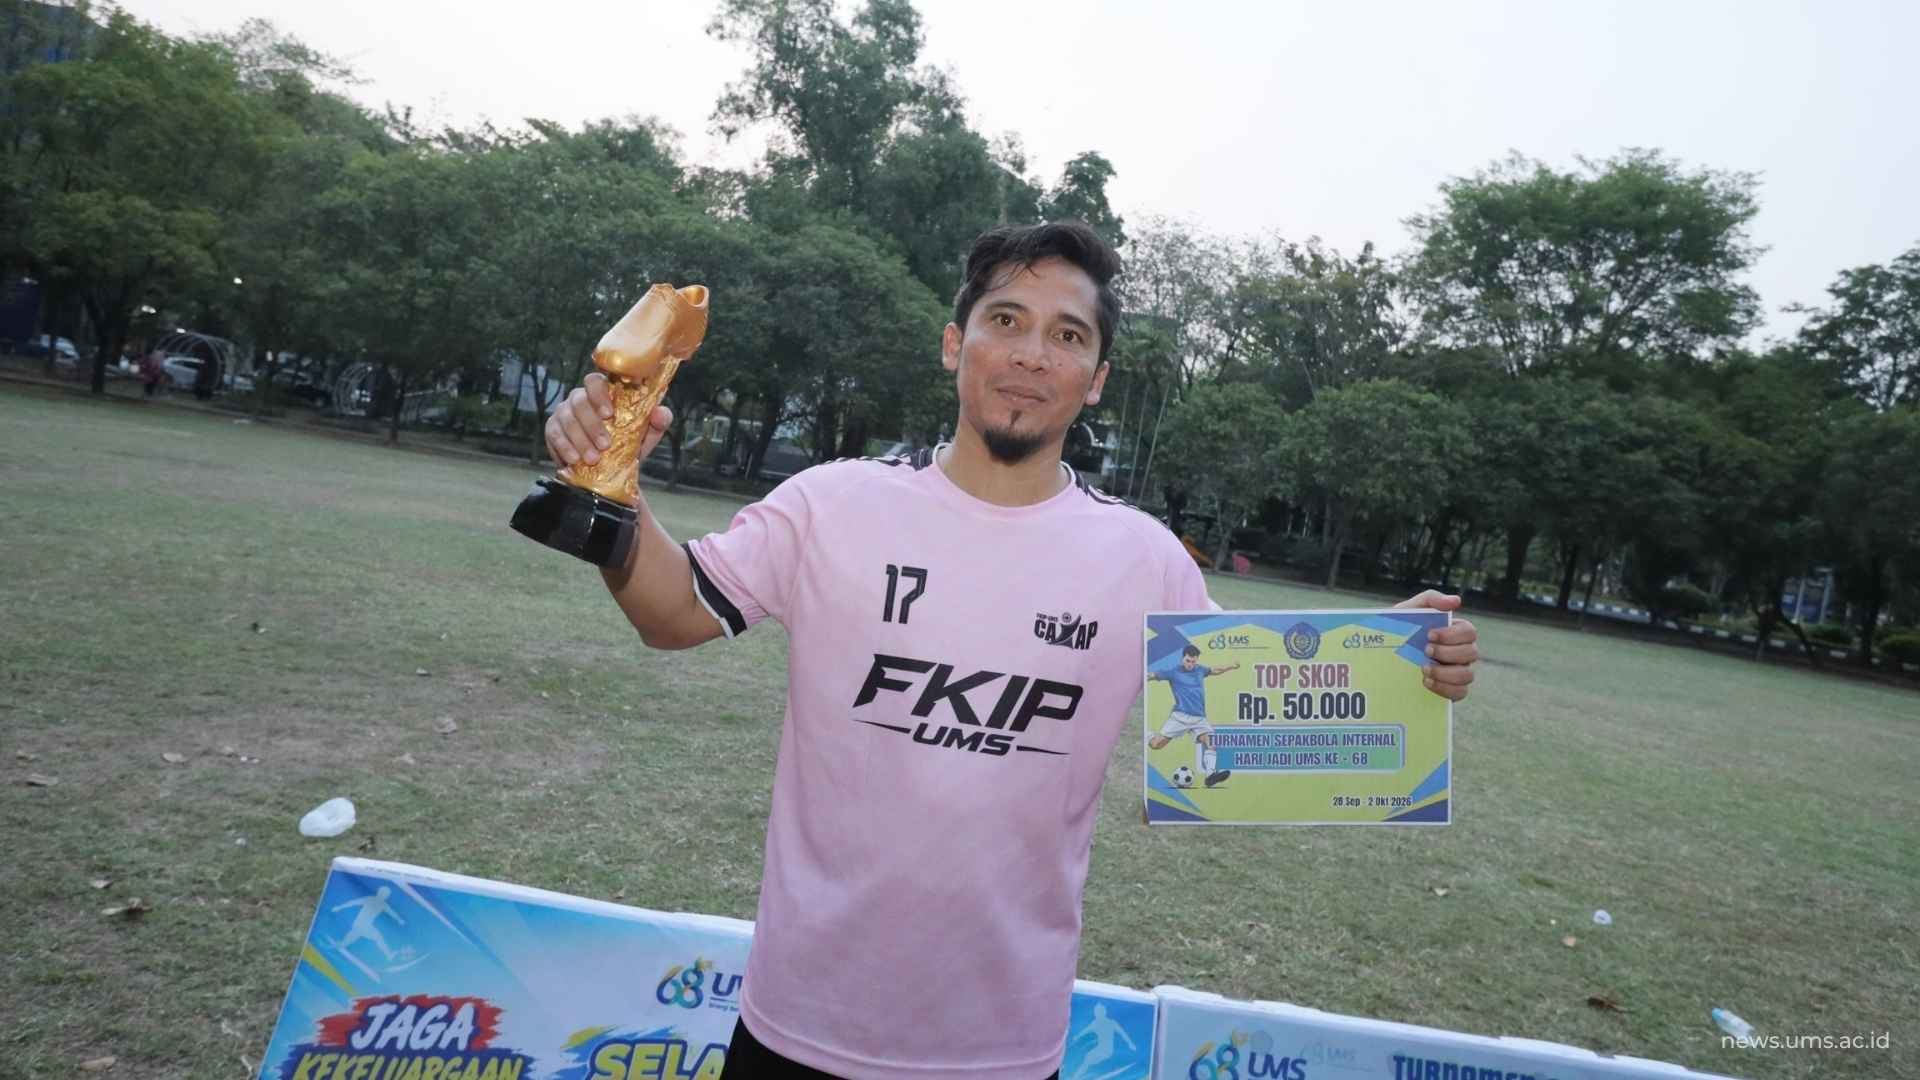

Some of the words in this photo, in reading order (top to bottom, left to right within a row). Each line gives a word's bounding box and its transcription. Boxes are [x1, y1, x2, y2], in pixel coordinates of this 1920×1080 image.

[882, 564, 928, 624] 17
[852, 653, 1084, 732] FKIP
[1254, 664, 1292, 689] TOP
[1298, 663, 1350, 688] SKOR
[1238, 693, 1275, 724] Rp.
[1283, 692, 1366, 720] 50.000
[912, 722, 1016, 756] UMS
[1209, 734, 1270, 747] TURNAMEN
[1274, 733, 1338, 746] SEPAKBOLA
[1343, 733, 1396, 746] INTERNAL
[1235, 753, 1263, 765] HARI
[1267, 753, 1291, 765] JADI
[1296, 752, 1321, 765] UMS
[1325, 752, 1339, 765] KE
[1352, 752, 1368, 765] 68
[350, 1002, 475, 1050] JAGA
